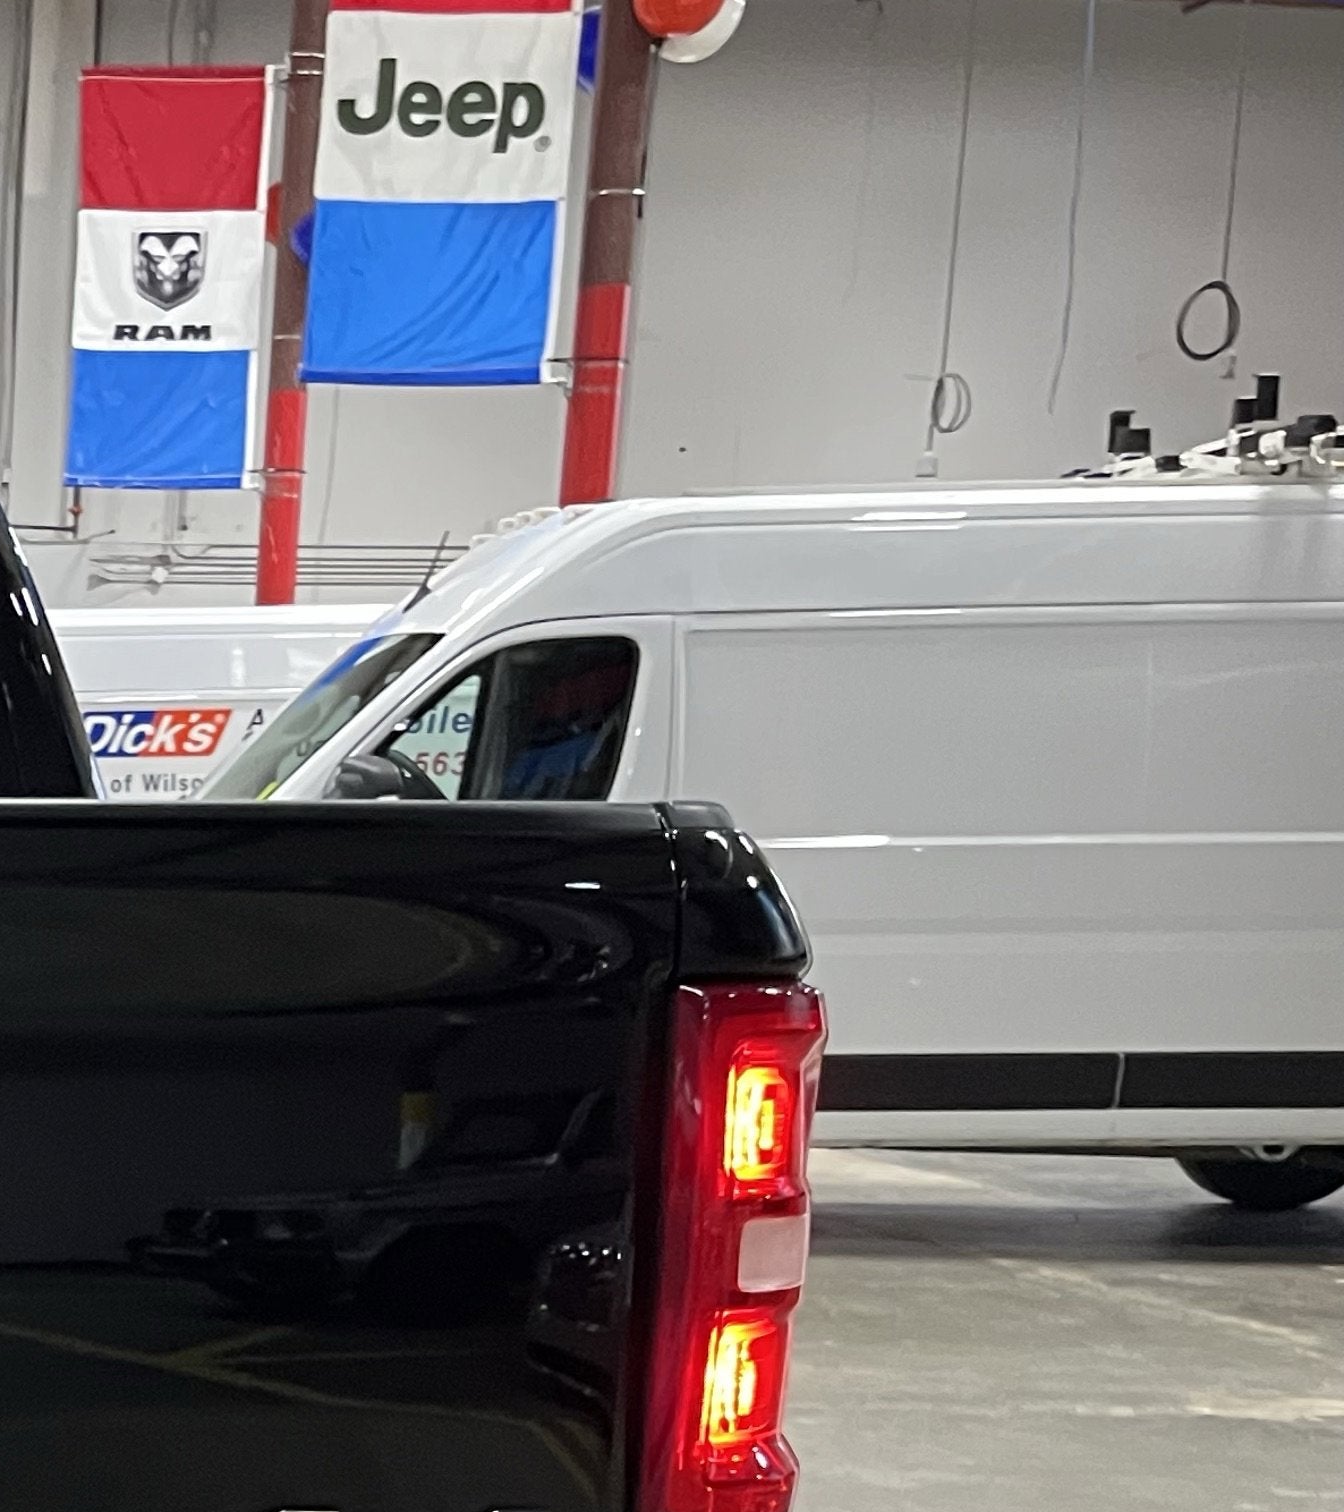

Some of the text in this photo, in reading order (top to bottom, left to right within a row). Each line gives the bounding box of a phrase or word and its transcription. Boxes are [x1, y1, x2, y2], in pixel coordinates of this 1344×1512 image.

[337, 58, 545, 153] Jeep
[113, 324, 212, 341] RAM
[111, 774, 133, 793] of
